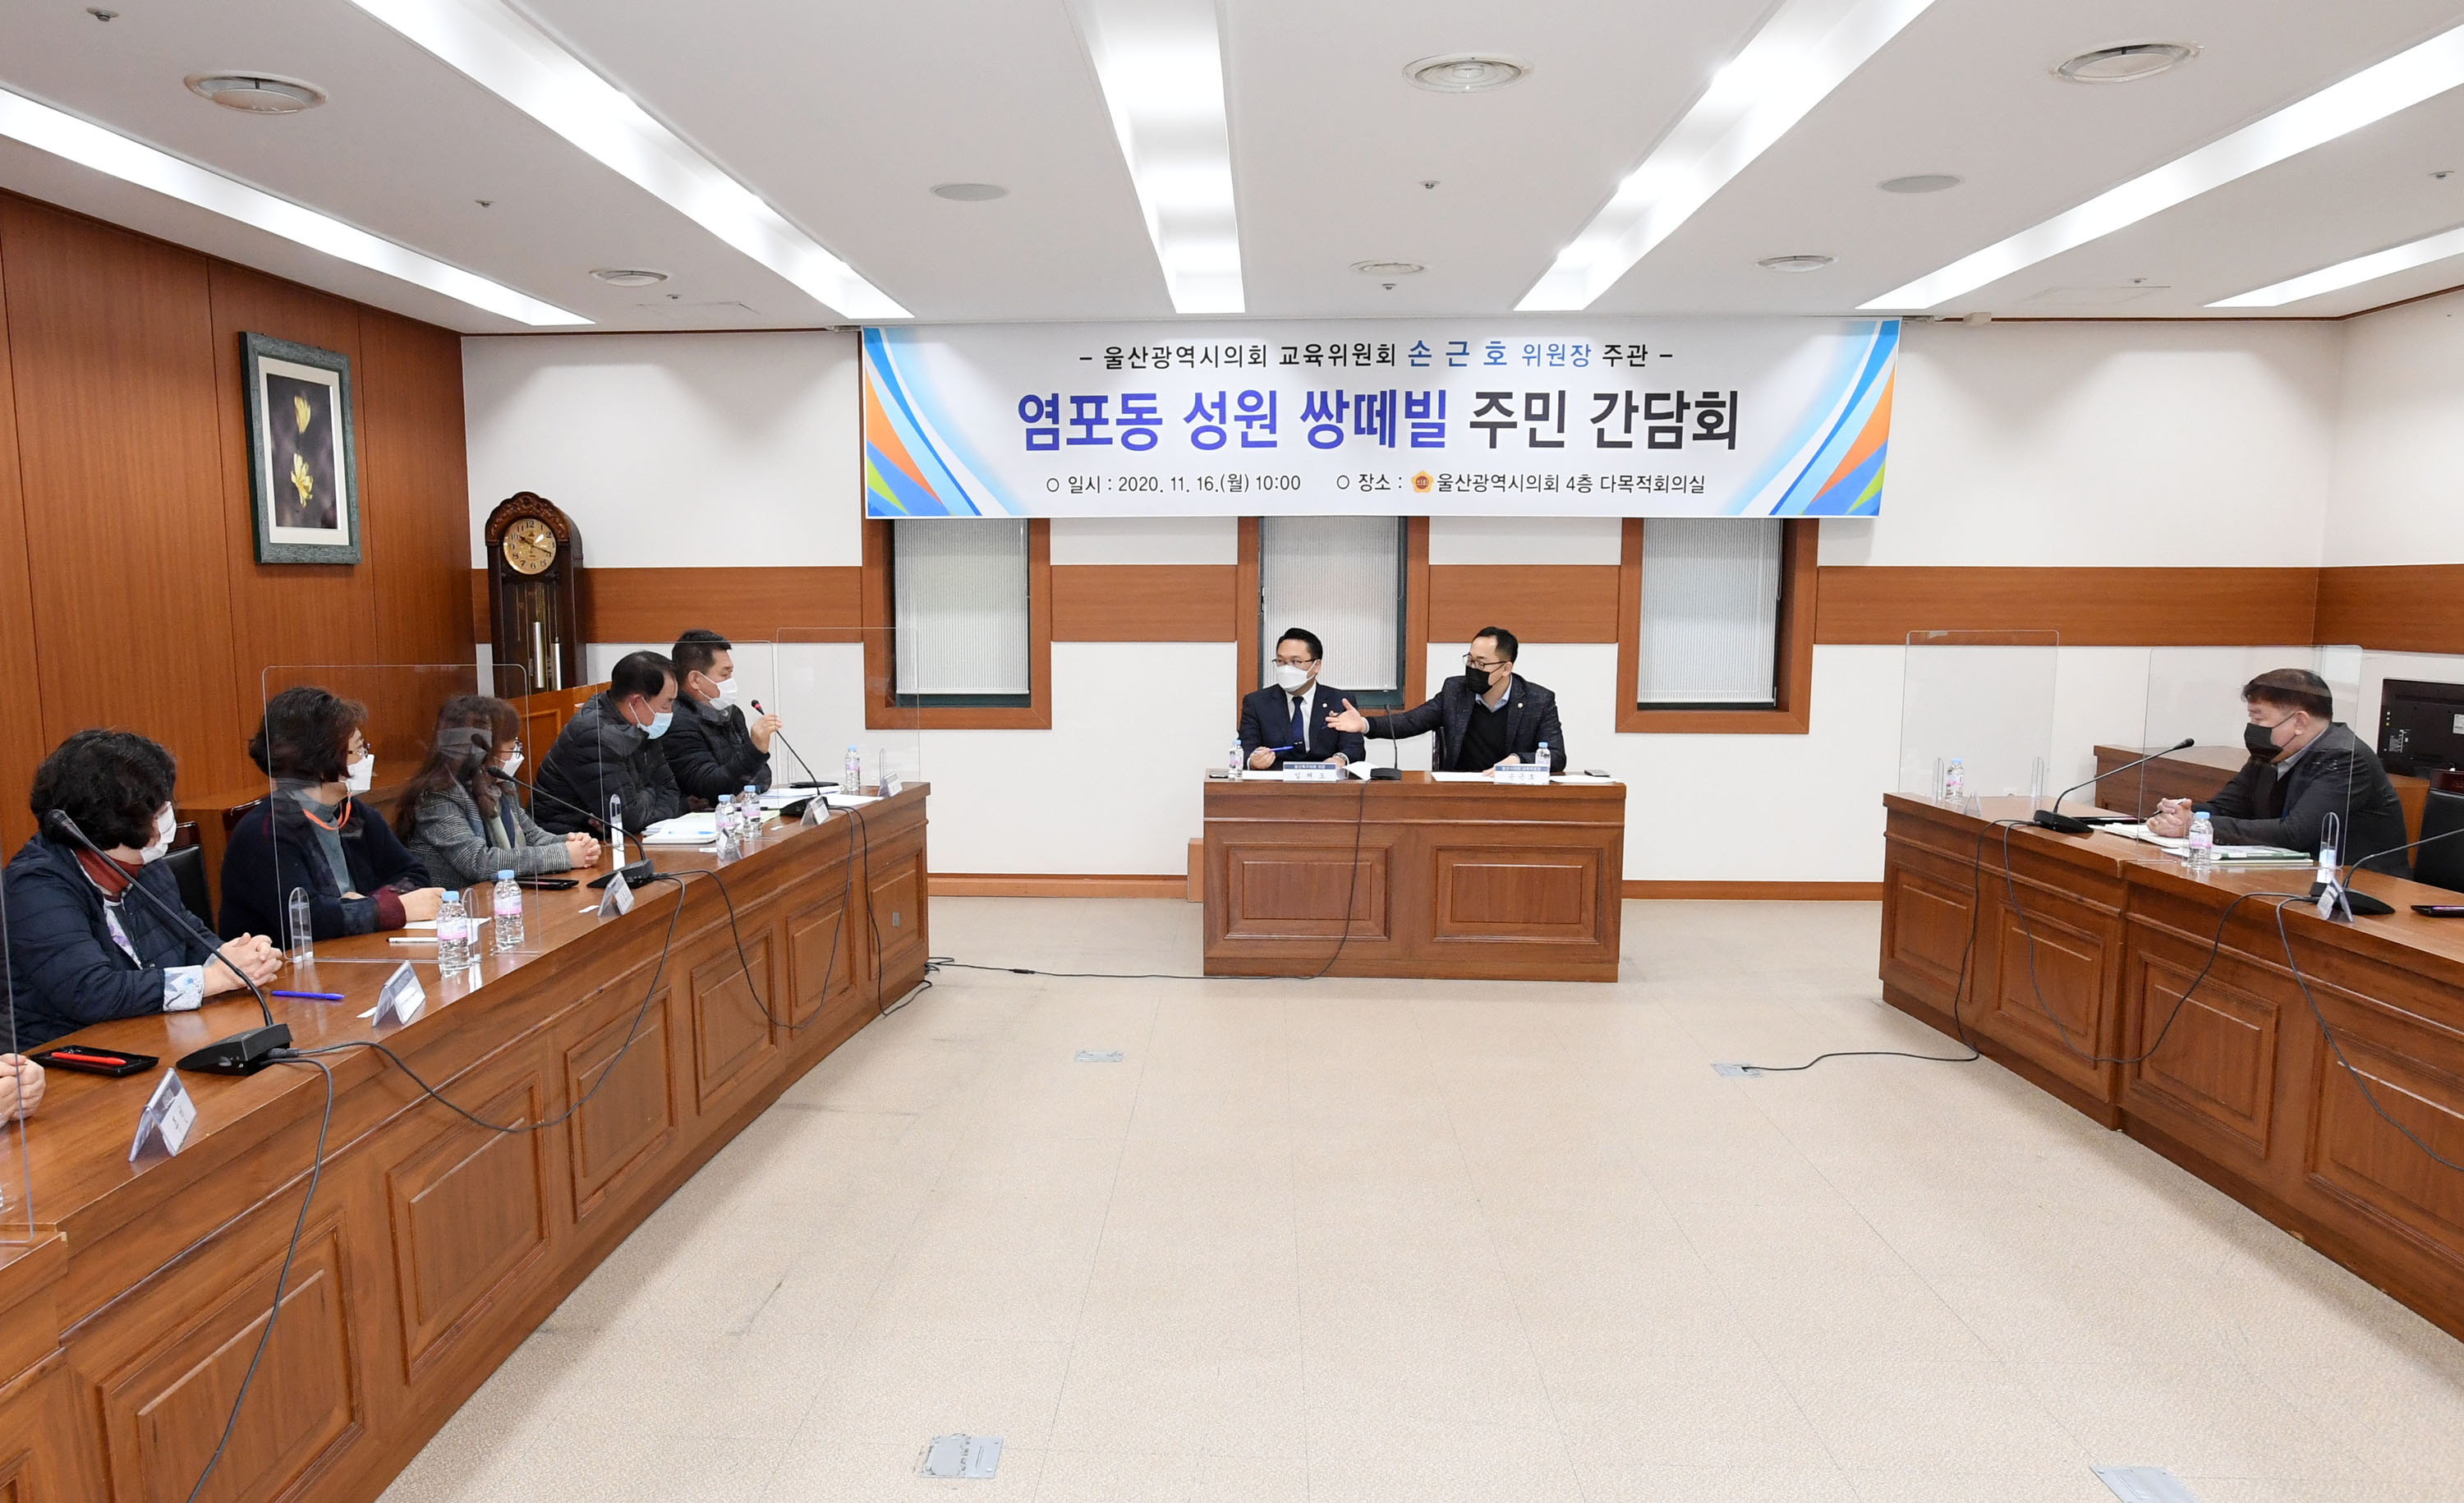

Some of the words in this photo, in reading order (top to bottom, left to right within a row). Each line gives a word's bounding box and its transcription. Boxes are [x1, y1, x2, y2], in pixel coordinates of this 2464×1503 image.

[1103, 343, 1266, 371] 울산광역시의회
[1279, 342, 1395, 369] 교육위원회
[1408, 339, 1432, 367] 손
[1445, 340, 1470, 367] 근
[1483, 340, 1507, 366] 호
[1522, 342, 1592, 368] 위원장
[1602, 342, 1648, 369] 주관
[1018, 392, 1163, 452] 염포동
[1183, 389, 1278, 451] 성원
[1299, 388, 1447, 450] 쌍떼빌
[1469, 389, 1566, 449] 주민
[1589, 389, 1739, 450] 간담회
[1068, 475, 1101, 494] 일시
[1118, 476, 1164, 494] 2020.
[1170, 476, 1190, 494] 11.
[1197, 473, 1249, 494] 16.(월)
[1256, 475, 1301, 492] 10:00
[1358, 473, 1391, 493] 장소
[1437, 473, 1559, 494] 울산광역시의회
[1565, 474, 1593, 494] 4층
[1600, 474, 1705, 494] 다목적회의실
